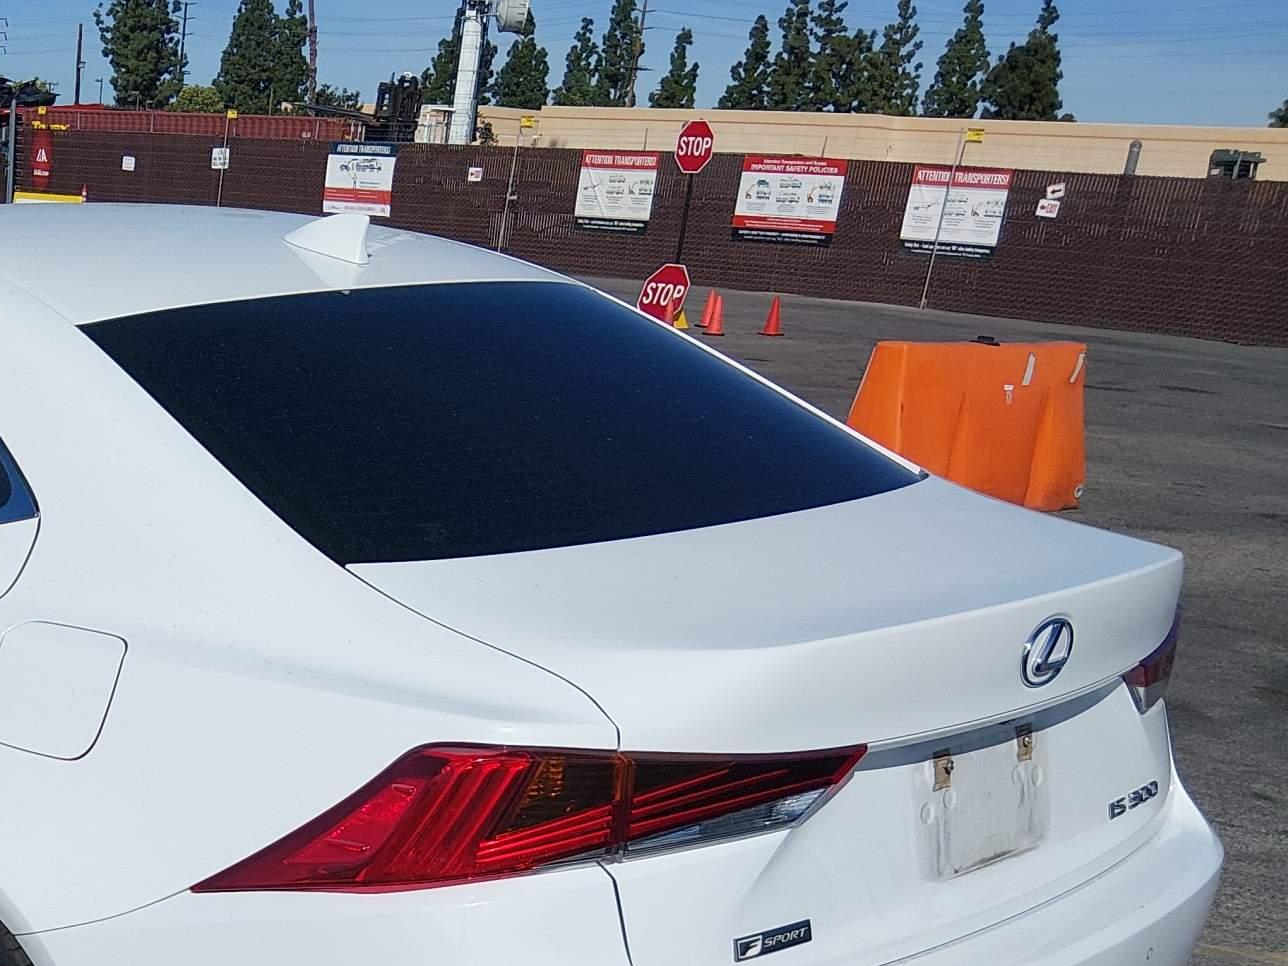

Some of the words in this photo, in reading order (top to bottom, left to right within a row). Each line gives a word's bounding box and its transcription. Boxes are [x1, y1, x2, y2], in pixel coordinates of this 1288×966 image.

[678, 136, 712, 157] STOP
[750, 163, 785, 172] IMPORTANT
[785, 165, 809, 173] SAFETY
[809, 166, 839, 174] POLICIES
[954, 171, 1010, 185] TRANSPORTERS!
[643, 282, 685, 306] STOP
[1108, 797, 1127, 820] IS
[1127, 781, 1159, 809] 300
[763, 926, 809, 948] SPORT
